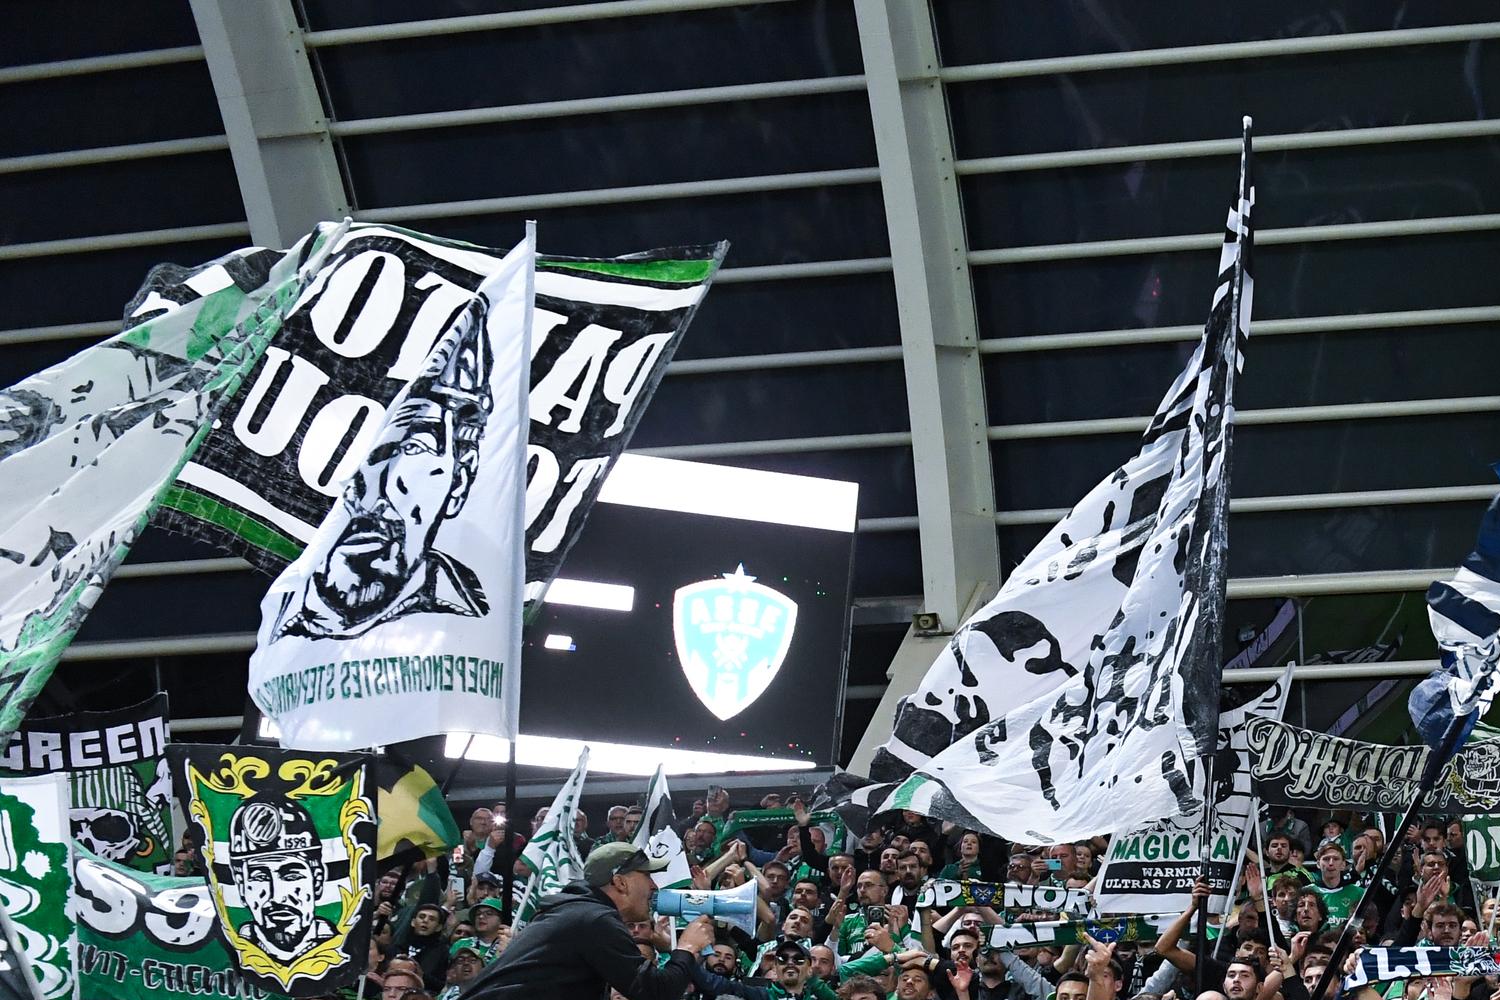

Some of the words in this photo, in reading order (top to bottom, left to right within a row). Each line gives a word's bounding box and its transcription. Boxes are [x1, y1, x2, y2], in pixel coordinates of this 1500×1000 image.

[1110, 834, 1190, 861] MAGIC
[1142, 867, 1212, 877] WARNIN
[1105, 879, 1161, 889] ULTRAS
